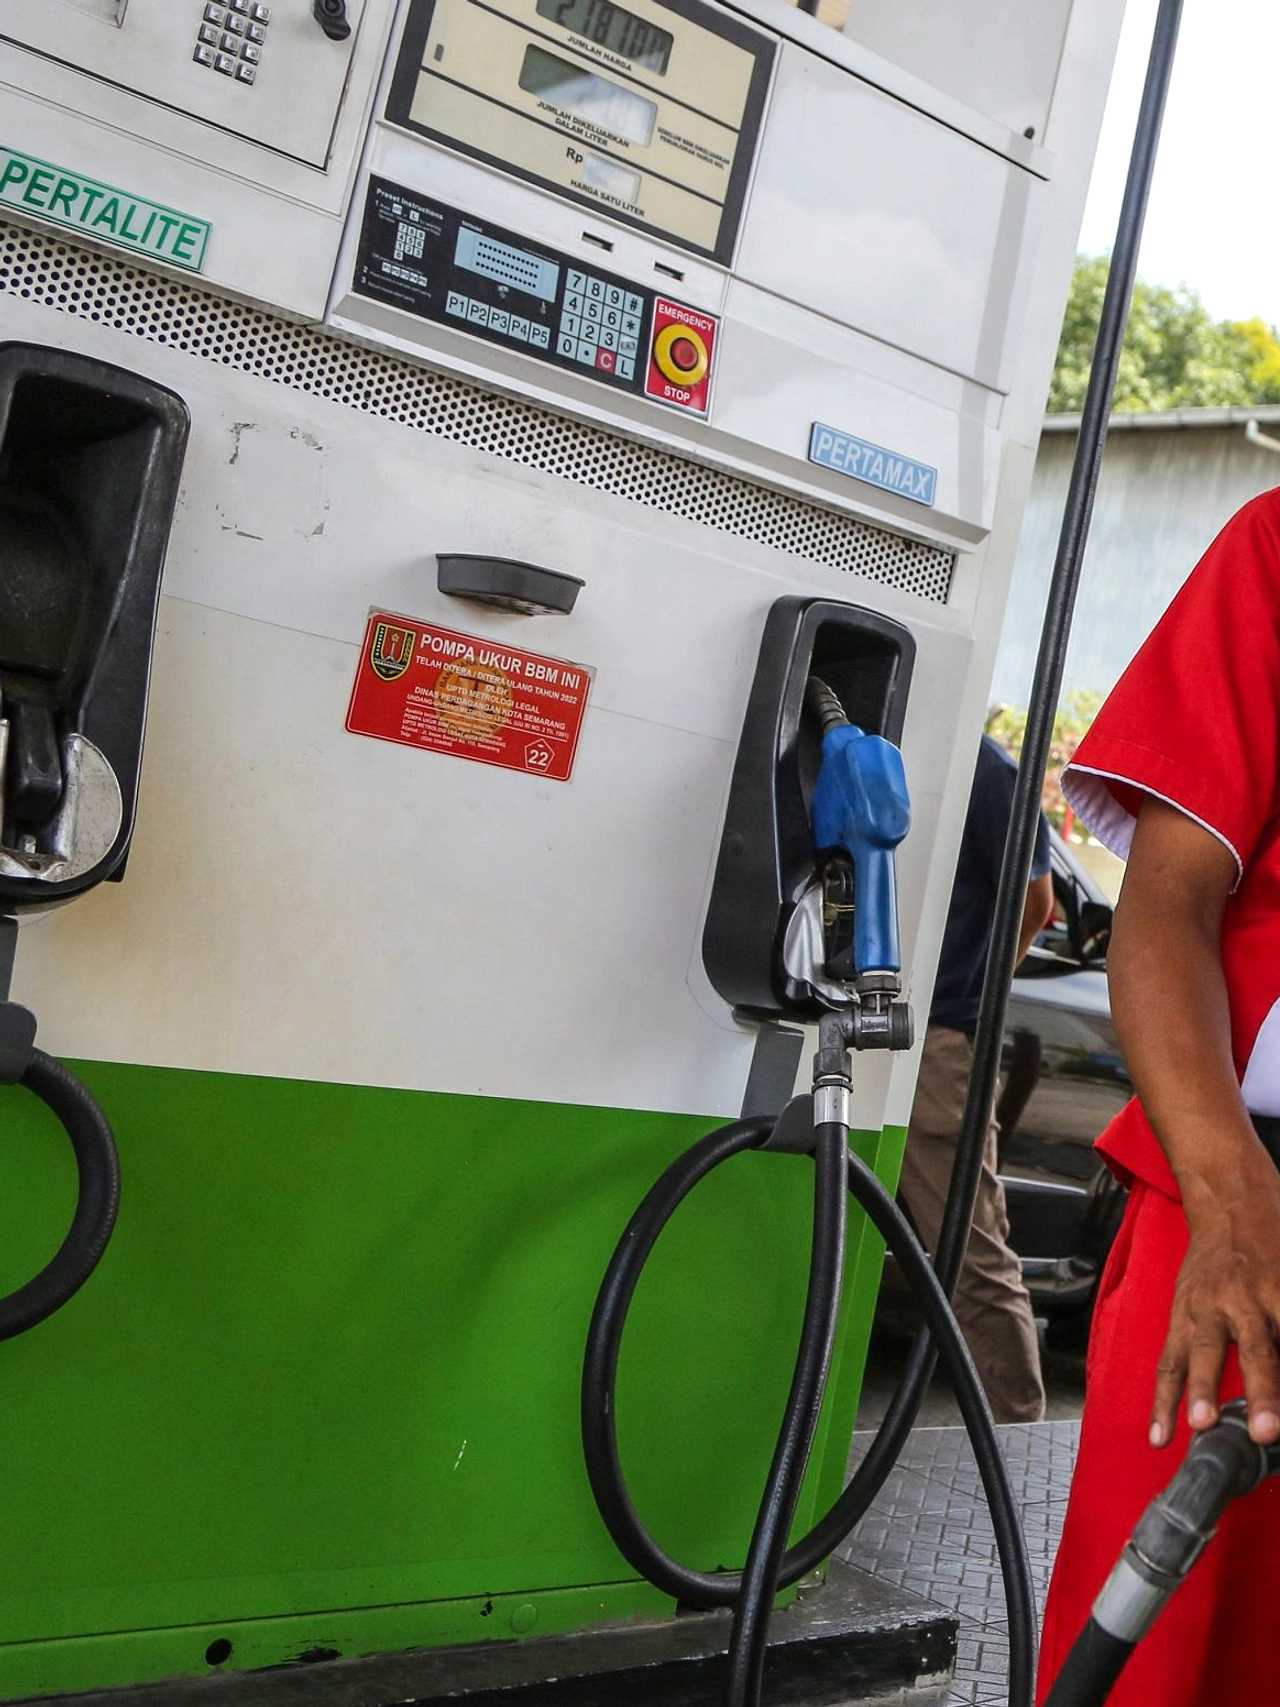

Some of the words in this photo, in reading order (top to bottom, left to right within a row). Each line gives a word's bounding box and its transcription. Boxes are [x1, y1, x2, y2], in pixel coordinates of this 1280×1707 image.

[567, 35, 602, 56] JUMLAH
[603, 52, 632, 71] HARGA
[536, 101, 571, 120] JUMLAH
[572, 116, 629, 148] DIKELUARKAN
[555, 117, 584, 136] DALAM
[585, 130, 609, 147] LITER
[566, 147, 584, 164] Rp
[0, 159, 201, 260] PERTALITE
[376, 187, 401, 203] Preset
[401, 198, 444, 220] Instructions
[570, 179, 599, 197] HARGA
[600, 191, 621, 206] SATU
[622, 201, 646, 217] LITER
[573, 275, 581, 288] 7
[592, 283, 600, 297] 8
[611, 290, 620, 304] 9
[449, 296, 464, 310] P1
[470, 304, 487, 321] P2
[491, 312, 508, 328] P3
[511, 320, 527, 336] P4
[532, 328, 547, 344] P5
[569, 297, 577, 310] 4
[588, 304, 597, 317] 5
[608, 311, 617, 325] 6
[658, 303, 713, 332] EMERGENCY
[568, 319, 574, 331] 1
[585, 325, 595, 340] 2
[605, 332, 614, 346] 3
[563, 339, 572, 353] 0
[600, 353, 612, 369] C
[621, 362, 629, 375] L
[664, 385, 691, 401] STOP
[816, 431, 932, 498] PERTAMAX
[420, 633, 475, 662] POMPA
[479, 649, 521, 674] UKUR
[525, 662, 558, 684] BBM
[561, 671, 580, 690] INI
[415, 655, 442, 669] TELAH
[443, 662, 472, 677] DITERA
[477, 671, 507, 686] DITERA
[507, 680, 533, 693] ULANG
[535, 686, 560, 700] TAHUN
[560, 693, 578, 704] 2022
[487, 685, 507, 695] OLEH
[414, 686, 440, 699] DINAS
[440, 694, 501, 713] PERDAGANGAN
[502, 709, 522, 720] KOTA
[523, 713, 565, 730] SEMARANG
[446, 684, 468, 695] UPTD
[469, 690, 514, 707] METROLOGI
[515, 701, 541, 714] LEGAL
[528, 749, 549, 767] 22
